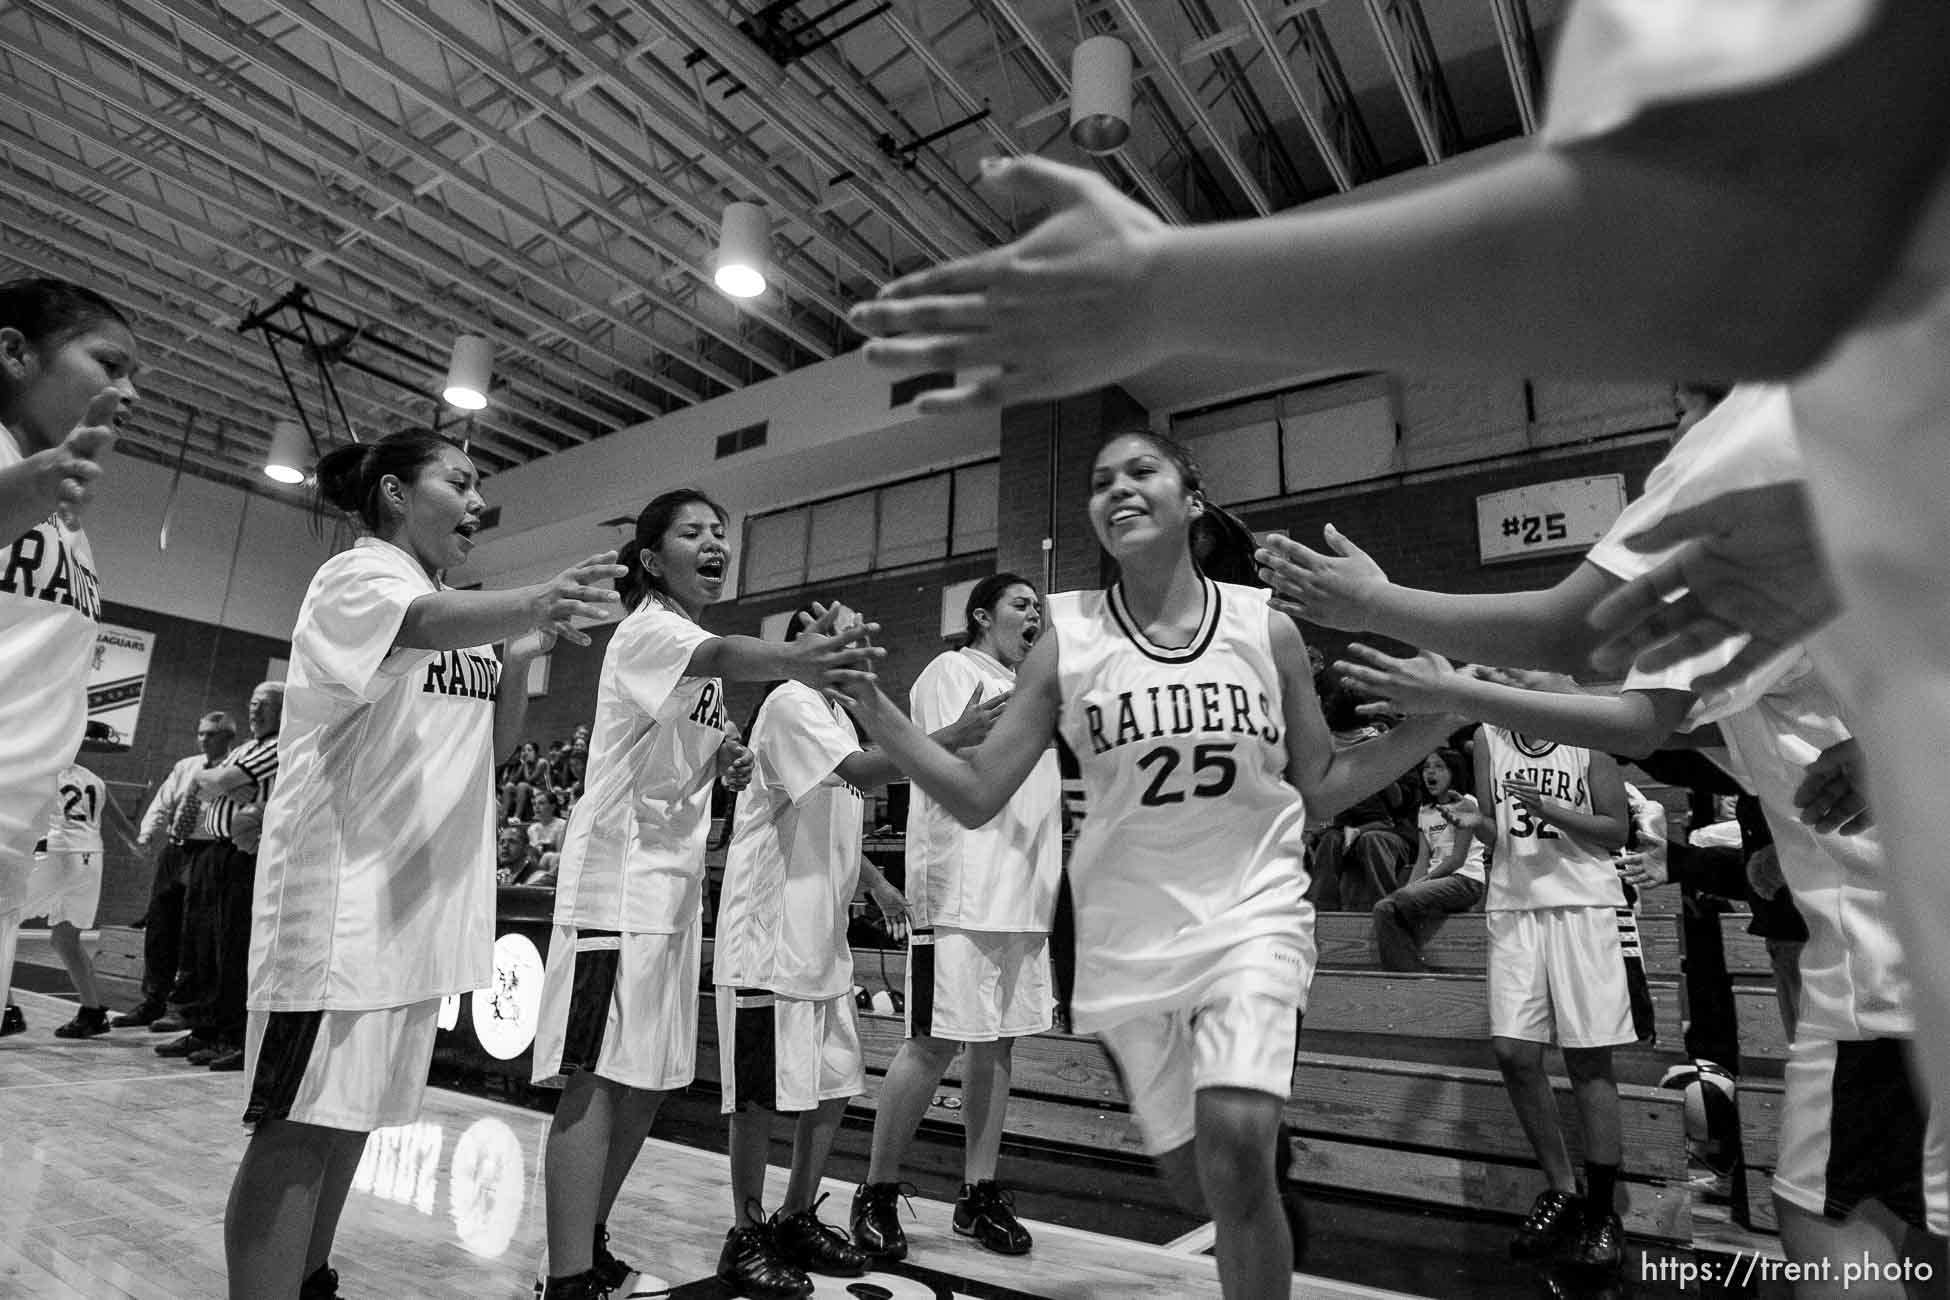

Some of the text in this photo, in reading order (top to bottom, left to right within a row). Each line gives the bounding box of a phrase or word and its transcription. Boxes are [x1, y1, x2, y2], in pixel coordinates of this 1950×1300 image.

[1502, 512, 1567, 545] #25
[1086, 682, 1280, 754] RAIDERS
[1136, 743, 1238, 806] 25
[60, 784, 97, 822] 21
